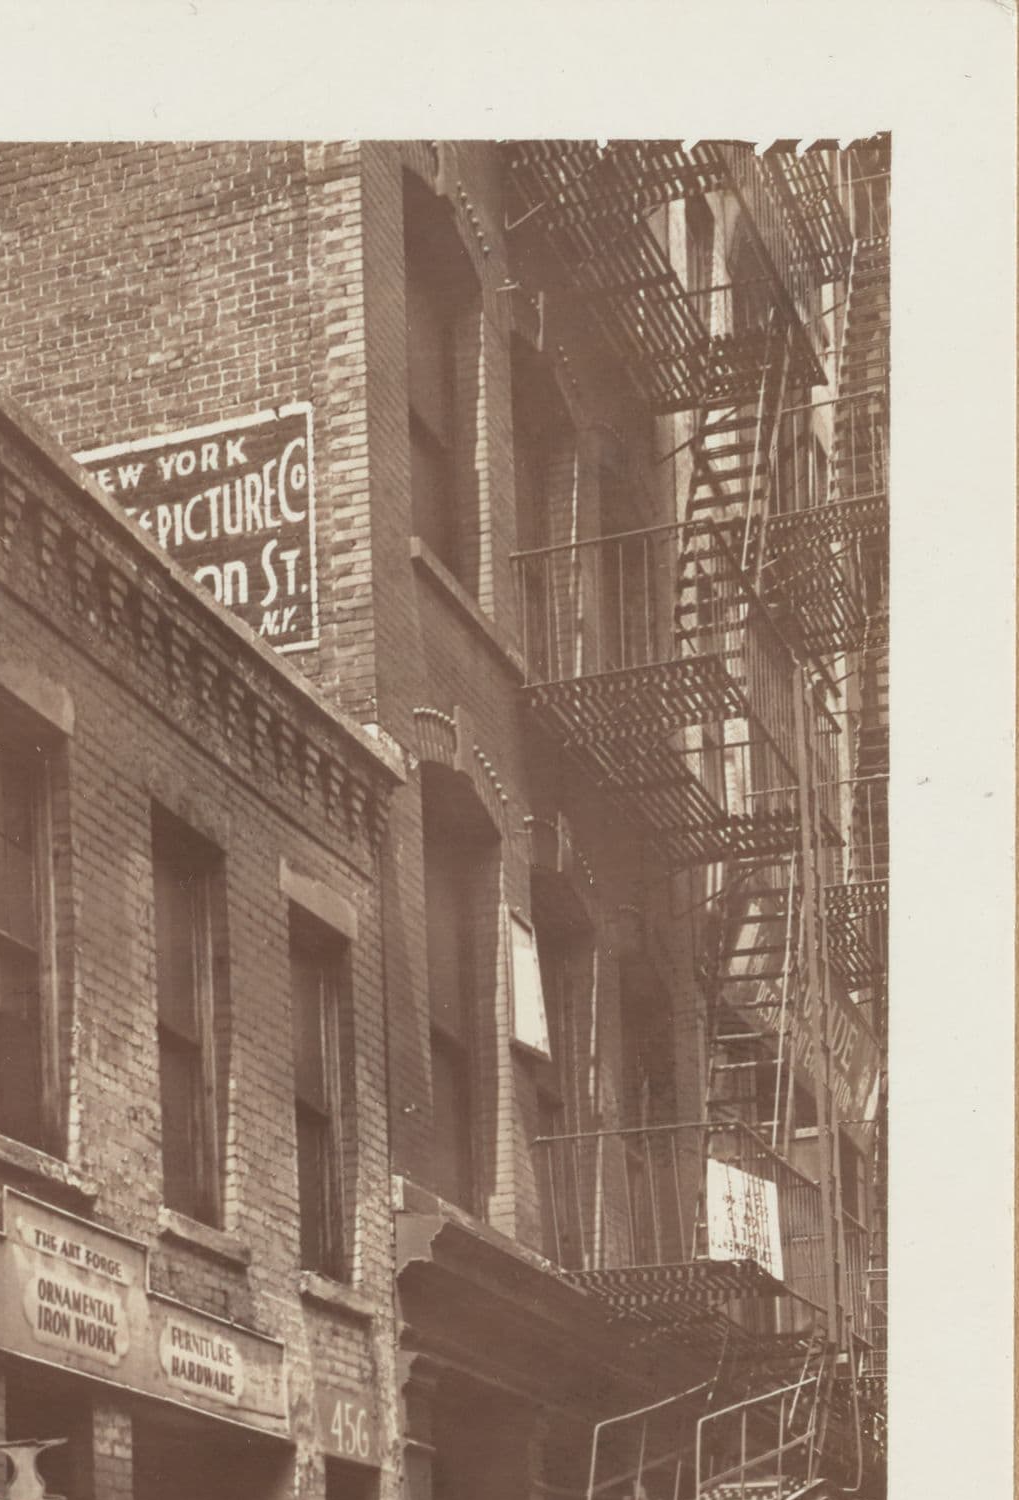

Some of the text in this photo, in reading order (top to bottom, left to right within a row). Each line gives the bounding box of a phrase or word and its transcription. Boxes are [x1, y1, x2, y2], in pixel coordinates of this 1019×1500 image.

[88, 436, 248, 492] EW YORK
[156, 458, 280, 549] PICTURE
[259, 605, 297, 637] N.Y.
[35, 1229, 122, 1278] THE ART FORGE
[38, 1278, 117, 1326] ORNAMENTAL
[38, 1304, 117, 1354] IRON WORK
[171, 1326, 233, 1367] FURNITURE
[171, 1355, 235, 1396] HARDWARE
[331, 1398, 369, 1457] 456
